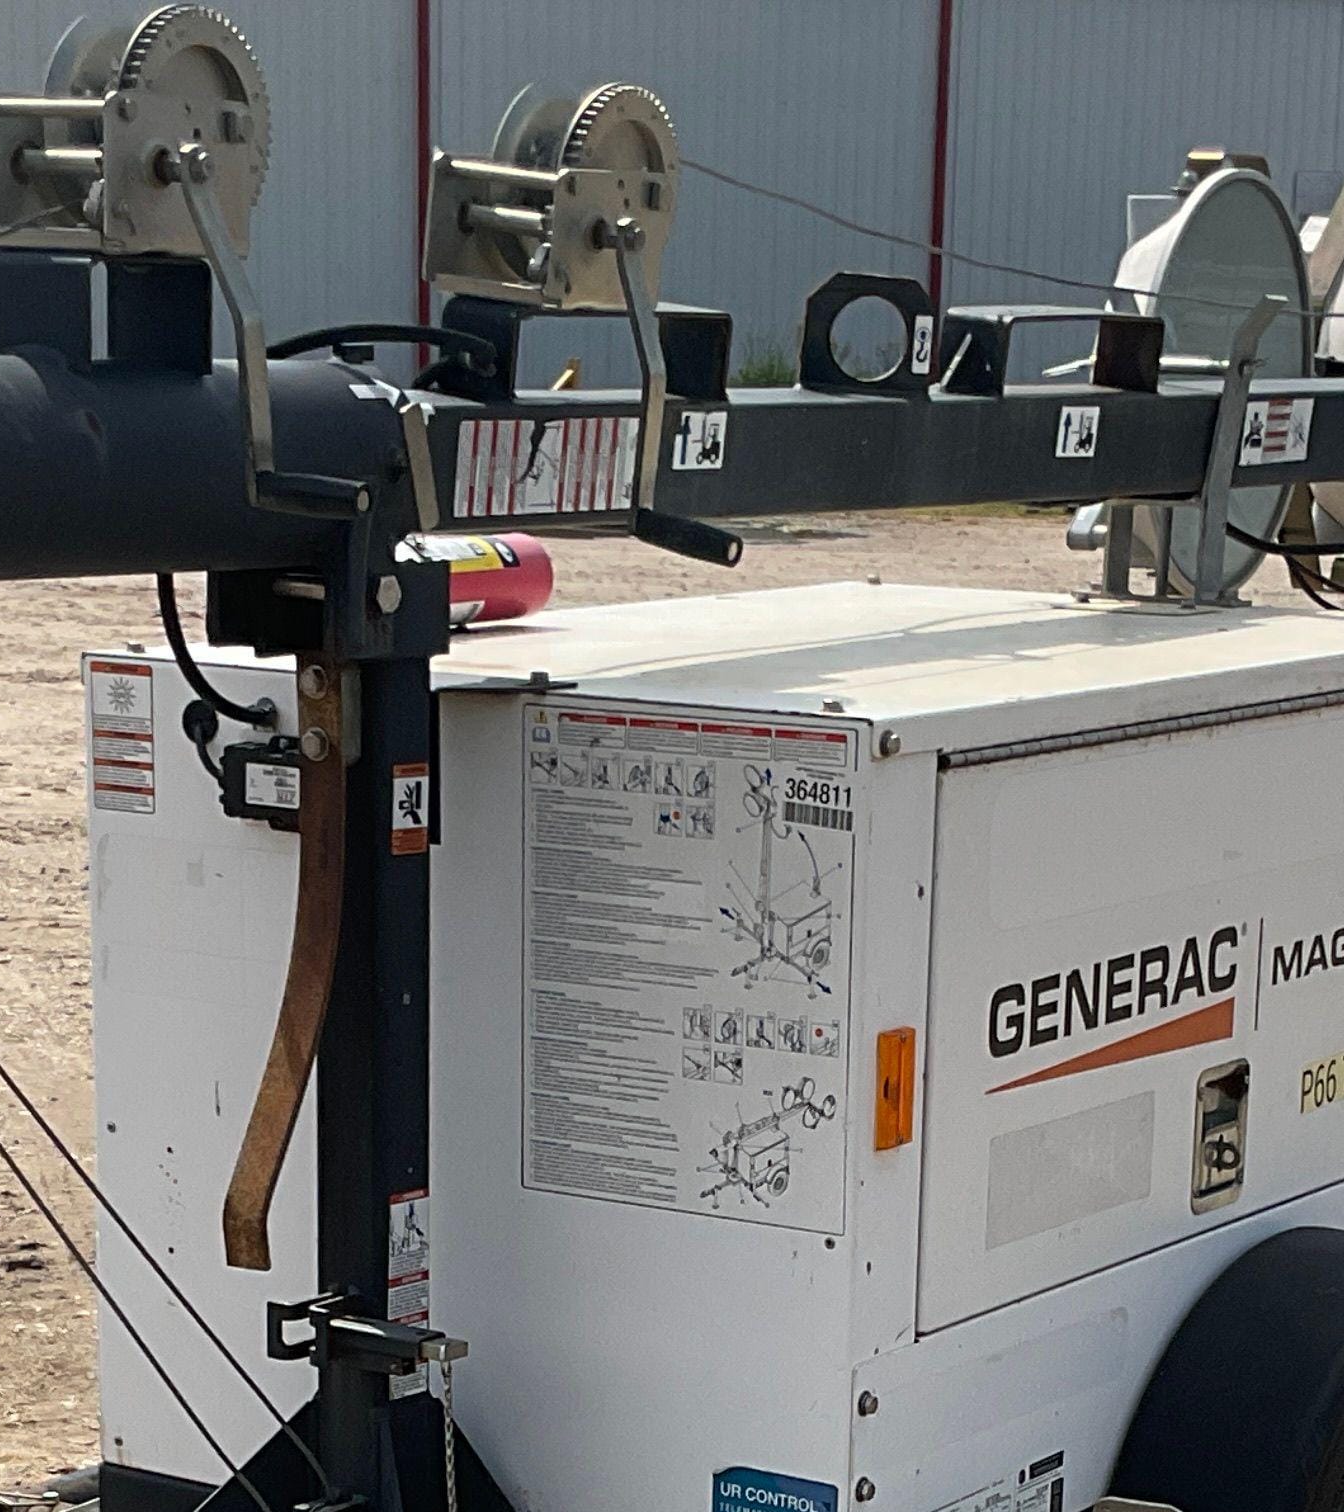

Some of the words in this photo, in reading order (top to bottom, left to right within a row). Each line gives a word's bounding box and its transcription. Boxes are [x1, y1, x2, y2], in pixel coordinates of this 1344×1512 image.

[784, 777, 852, 808] 364811
[988, 925, 1238, 1060] GENERAC
[1300, 1059, 1337, 1114] P66
[719, 1481, 742, 1499] UR
